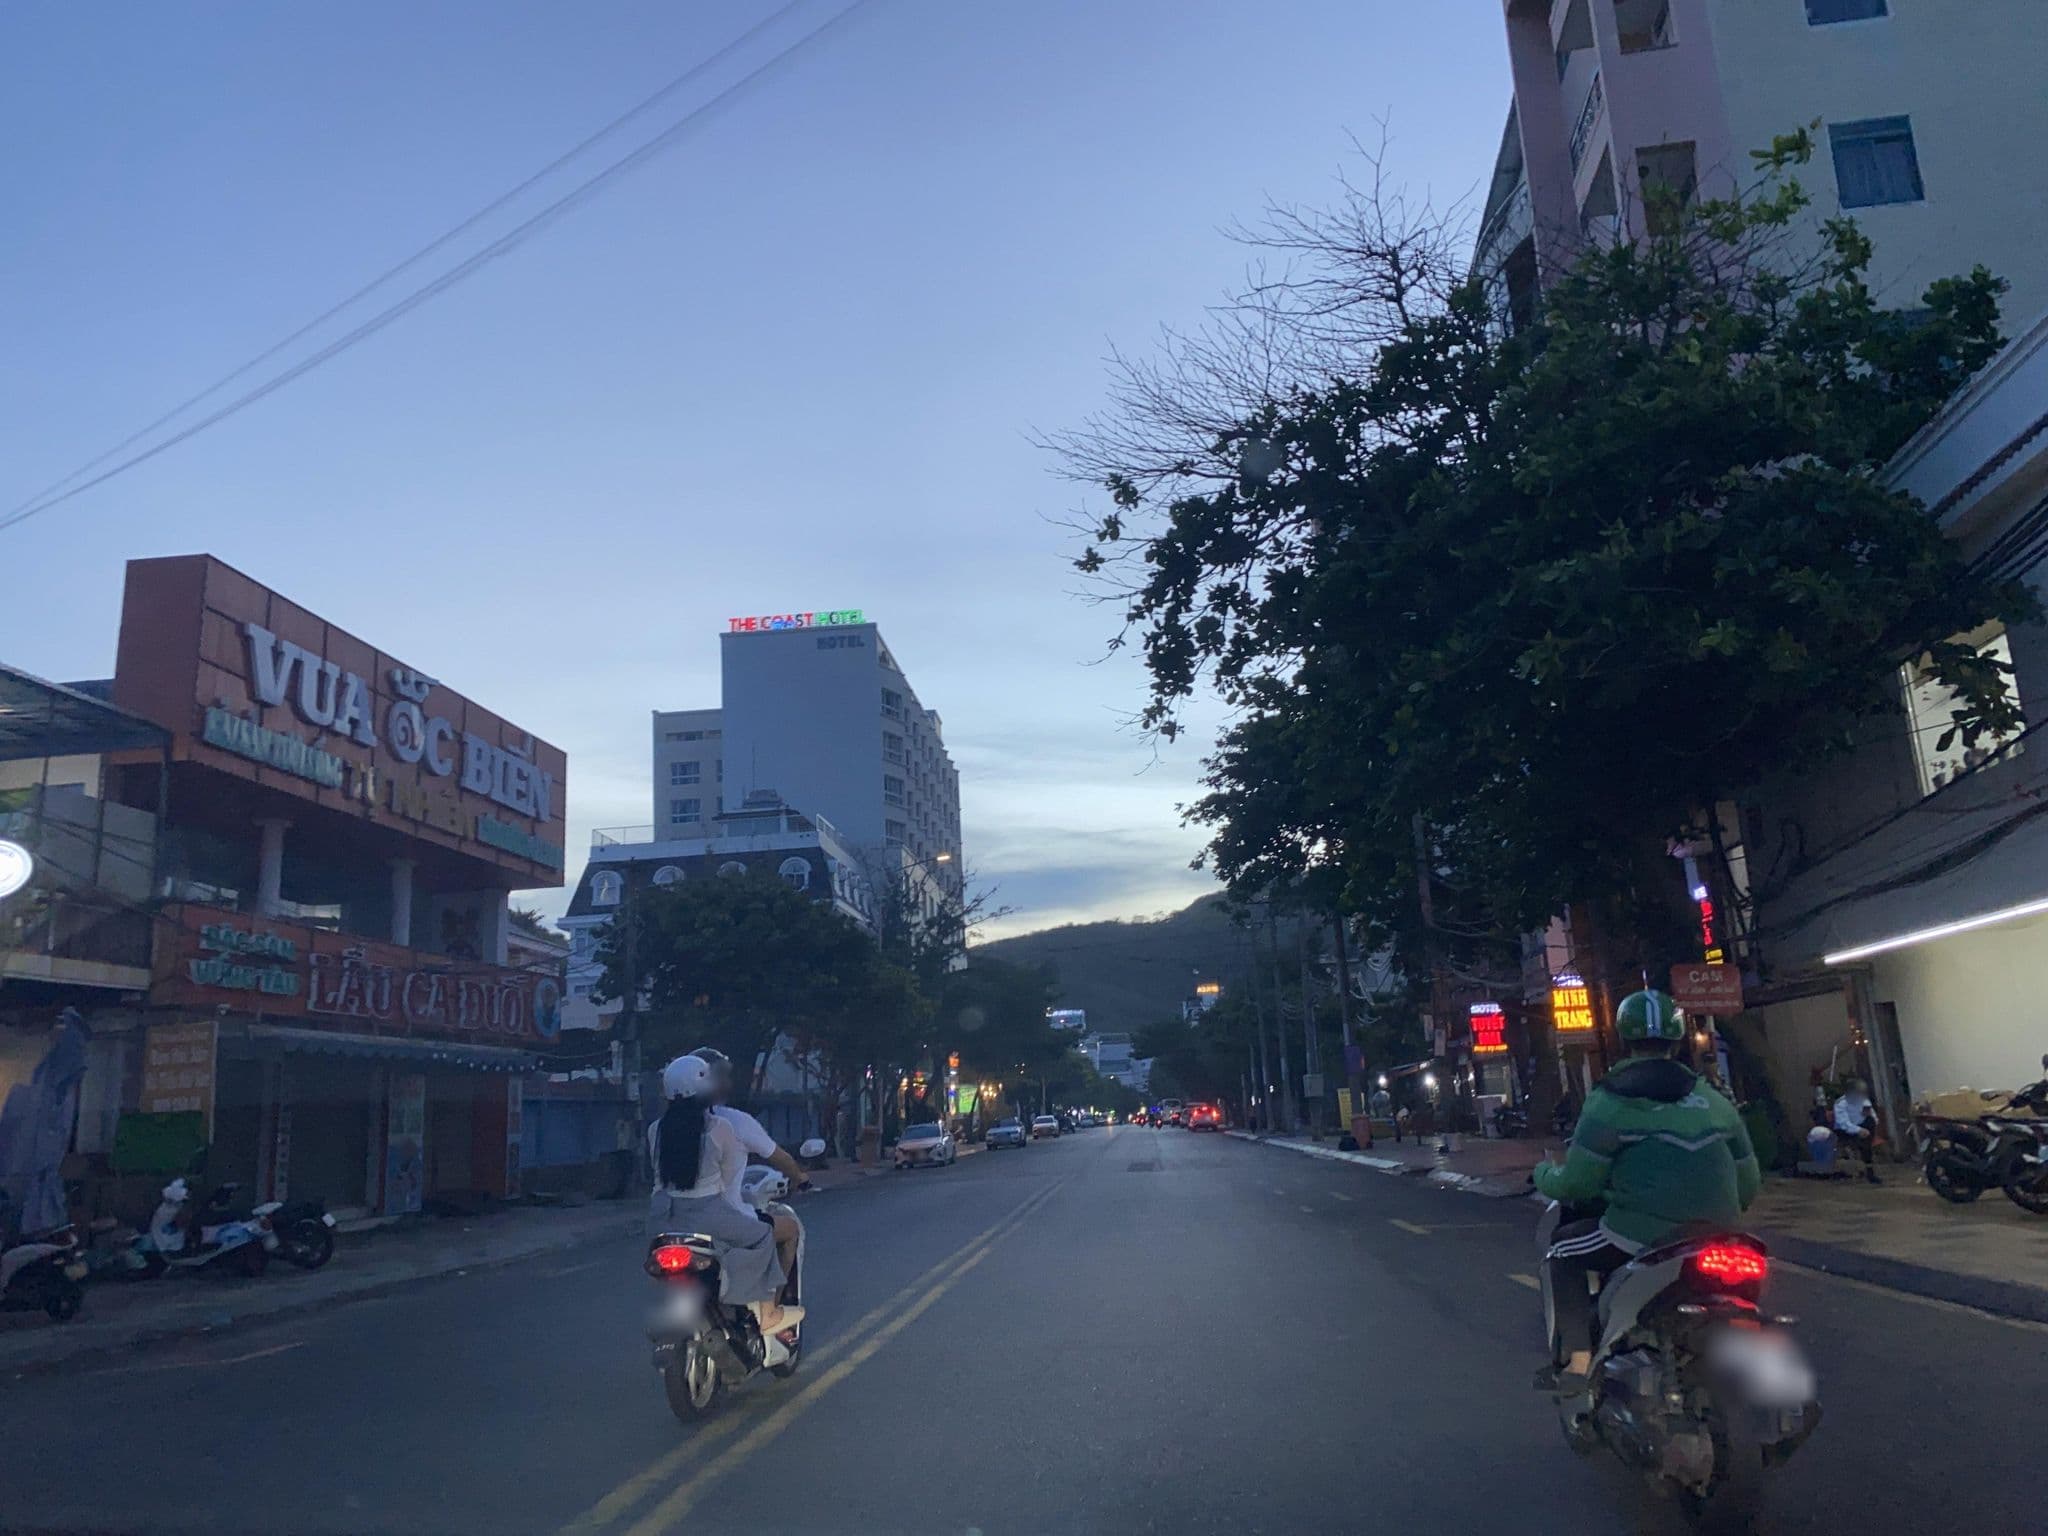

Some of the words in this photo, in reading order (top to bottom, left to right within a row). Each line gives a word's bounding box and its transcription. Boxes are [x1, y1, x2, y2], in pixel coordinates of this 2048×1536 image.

[729, 617, 757, 633] THE
[760, 613, 813, 631] COAST
[815, 609, 866, 626] HOTEL
[816, 635, 865, 650] HOTEL
[244, 622, 378, 748] VUA
[1552, 988, 1589, 1008] MINH
[1554, 1009, 1593, 1029] TRANG
